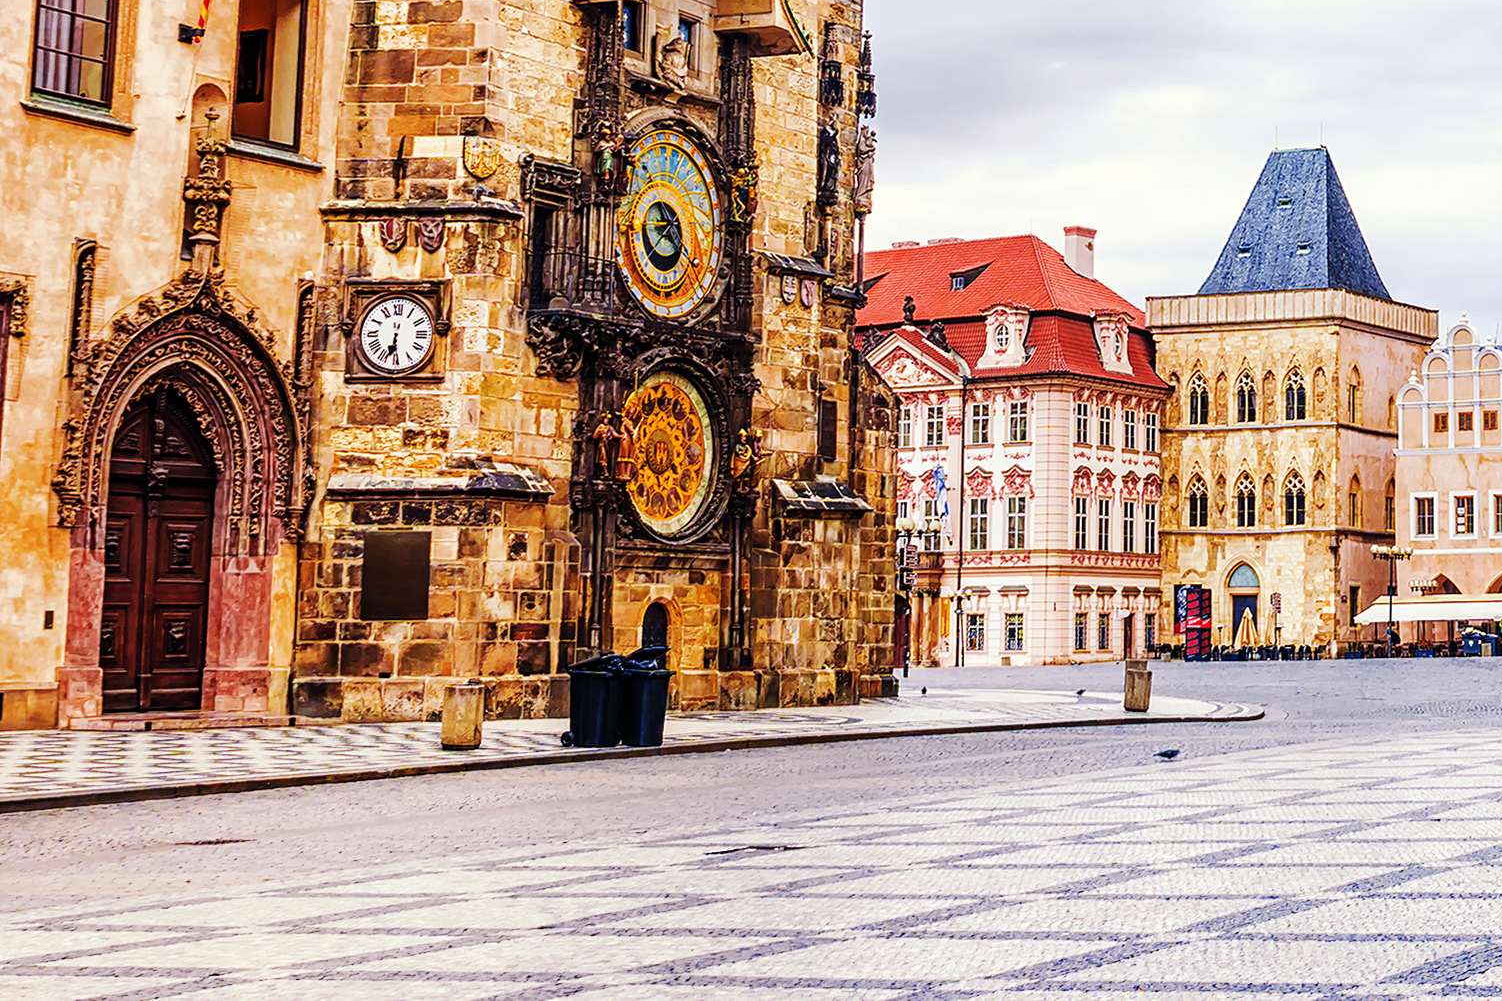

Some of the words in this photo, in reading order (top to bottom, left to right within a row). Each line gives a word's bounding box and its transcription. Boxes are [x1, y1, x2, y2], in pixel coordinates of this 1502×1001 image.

[407, 308, 415, 318] I
[413, 317, 425, 327] II
[416, 330, 427, 339] III
